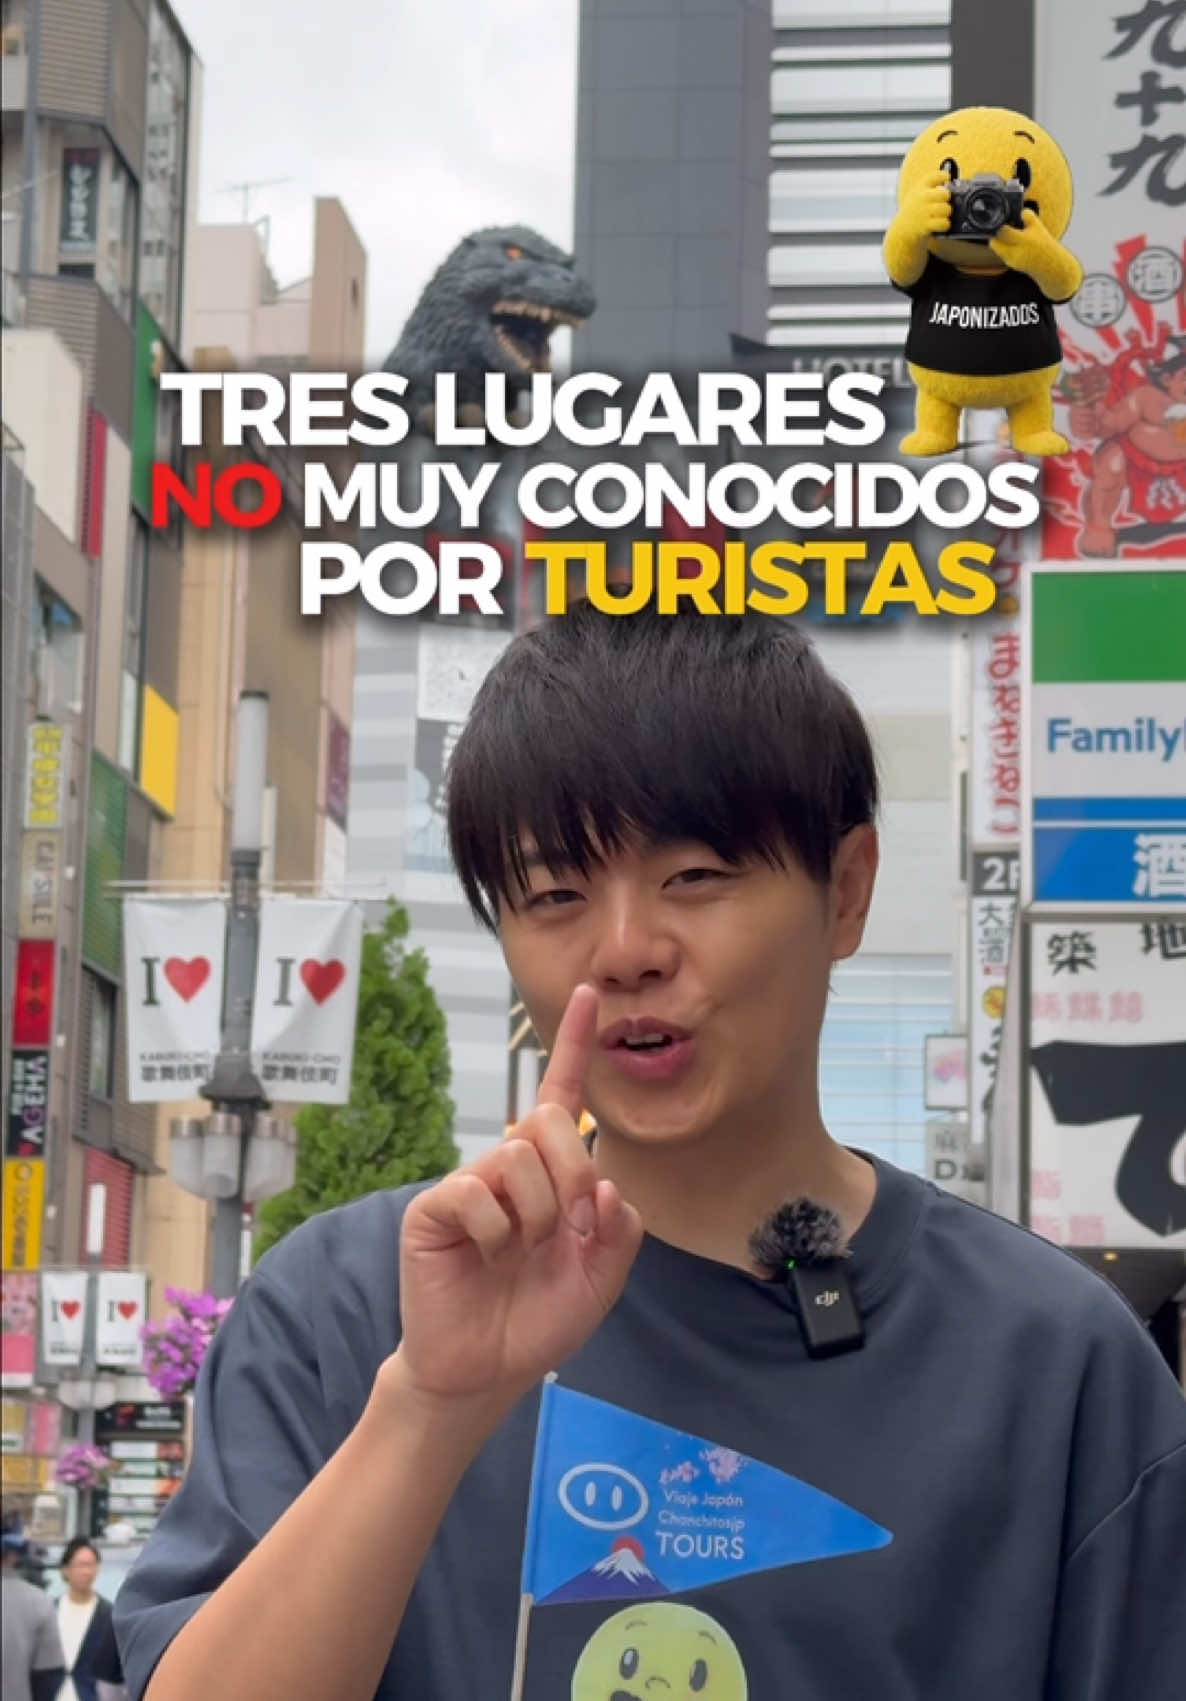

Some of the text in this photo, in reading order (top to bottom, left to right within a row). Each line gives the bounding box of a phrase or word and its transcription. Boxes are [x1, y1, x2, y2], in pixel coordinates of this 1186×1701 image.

[1047, 718, 1186, 763] Family
[141, 957, 161, 1007] I
[274, 957, 295, 1007] I
[655, 1530, 745, 1560] TOURS
